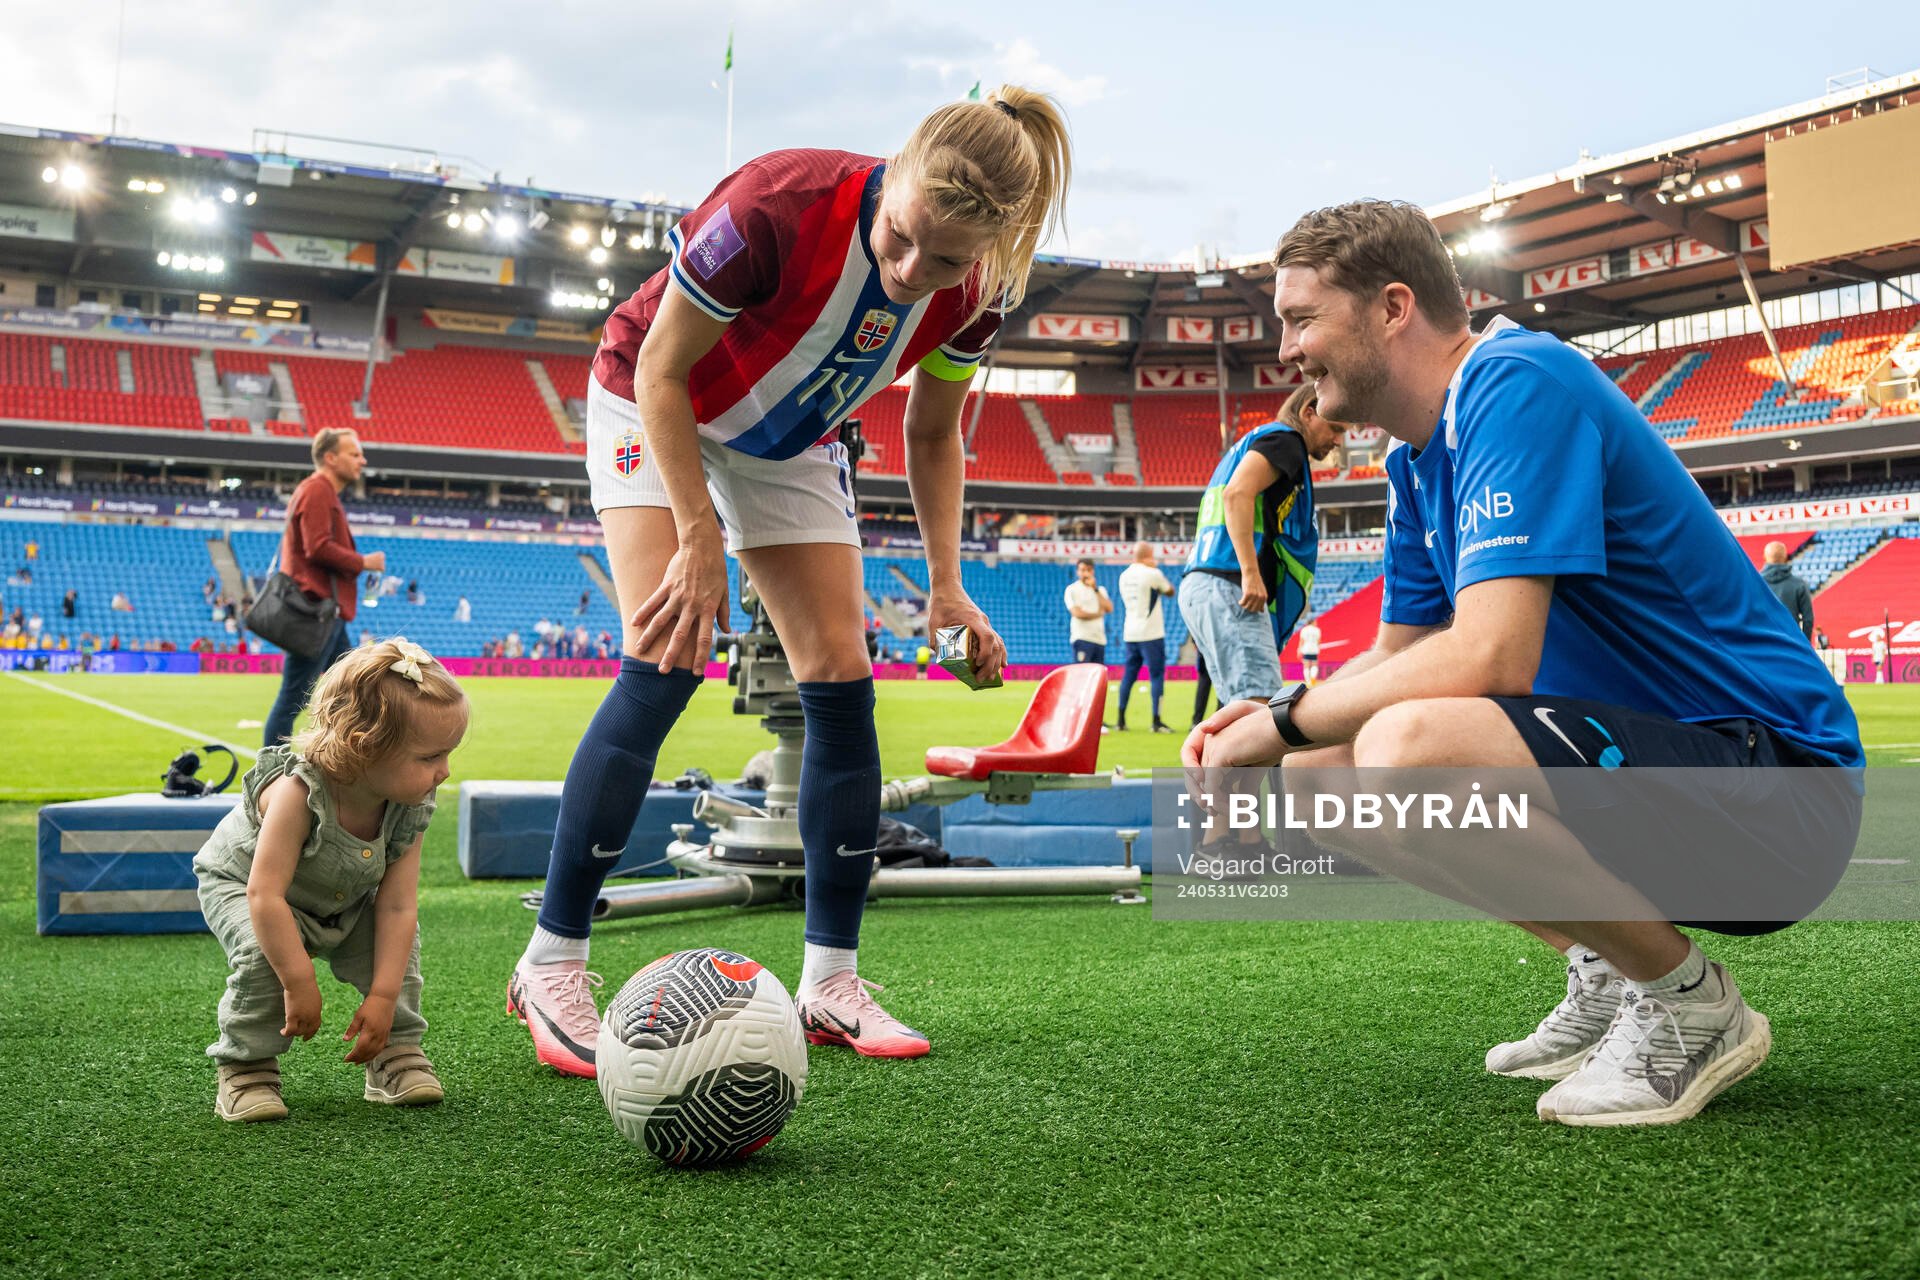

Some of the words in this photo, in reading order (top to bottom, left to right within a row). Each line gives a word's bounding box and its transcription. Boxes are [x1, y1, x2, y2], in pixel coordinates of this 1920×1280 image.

[1531, 258, 1600, 297] VG
[1039, 317, 1119, 338] VG
[1177, 319, 1255, 341] VG
[1141, 366, 1219, 388] VG
[1260, 366, 1304, 386] V
[797, 368, 865, 421] 14
[1459, 486, 1514, 534] DNB
[1751, 508, 1794, 522] VG
[1804, 503, 1850, 518] VG
[1861, 499, 1909, 515] VG
[472, 662, 531, 677] ZERO
[541, 662, 613, 678] SUGAR
